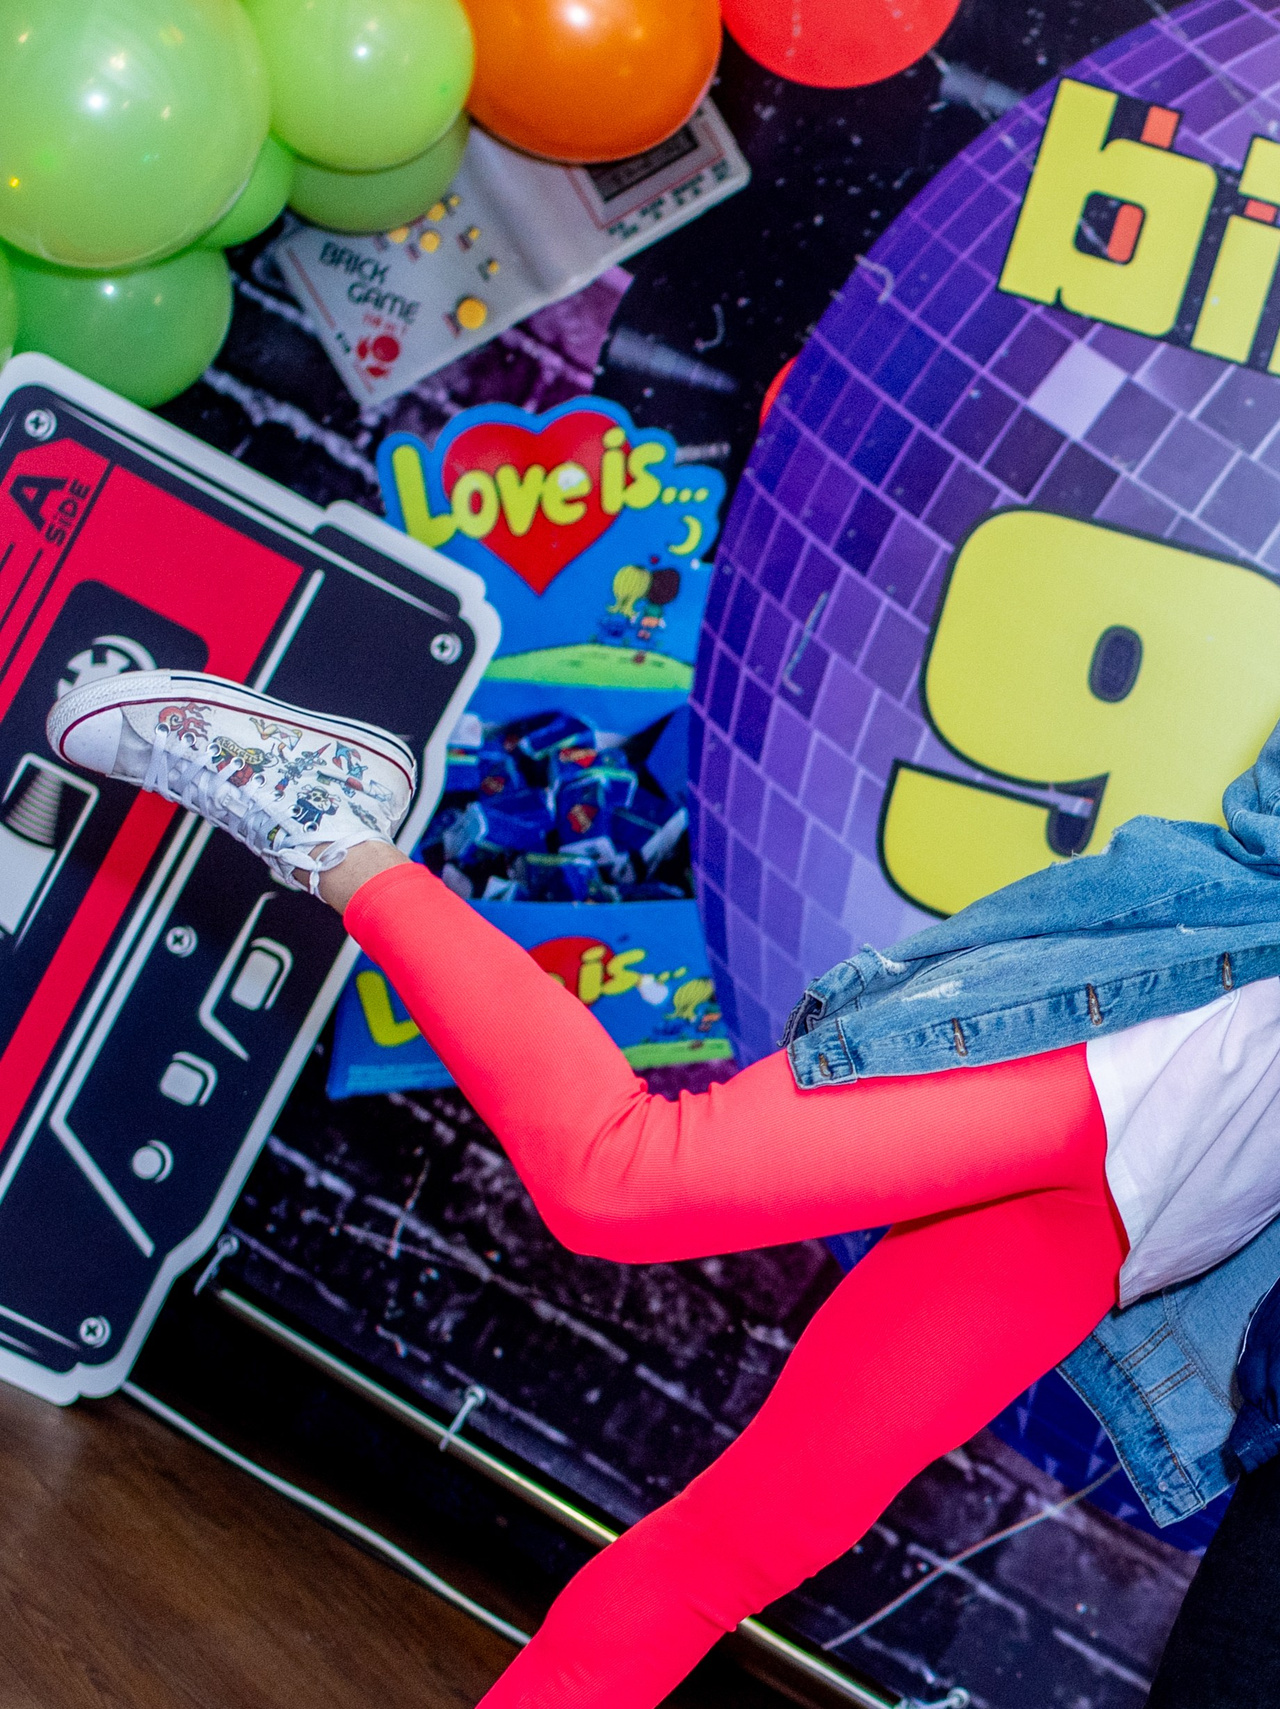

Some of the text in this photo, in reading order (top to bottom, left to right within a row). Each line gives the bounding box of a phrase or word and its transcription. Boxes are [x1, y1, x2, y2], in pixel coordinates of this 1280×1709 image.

[320, 241, 390, 284] BRICK
[8, 474, 68, 532] A
[392, 426, 709, 550] Love is...
